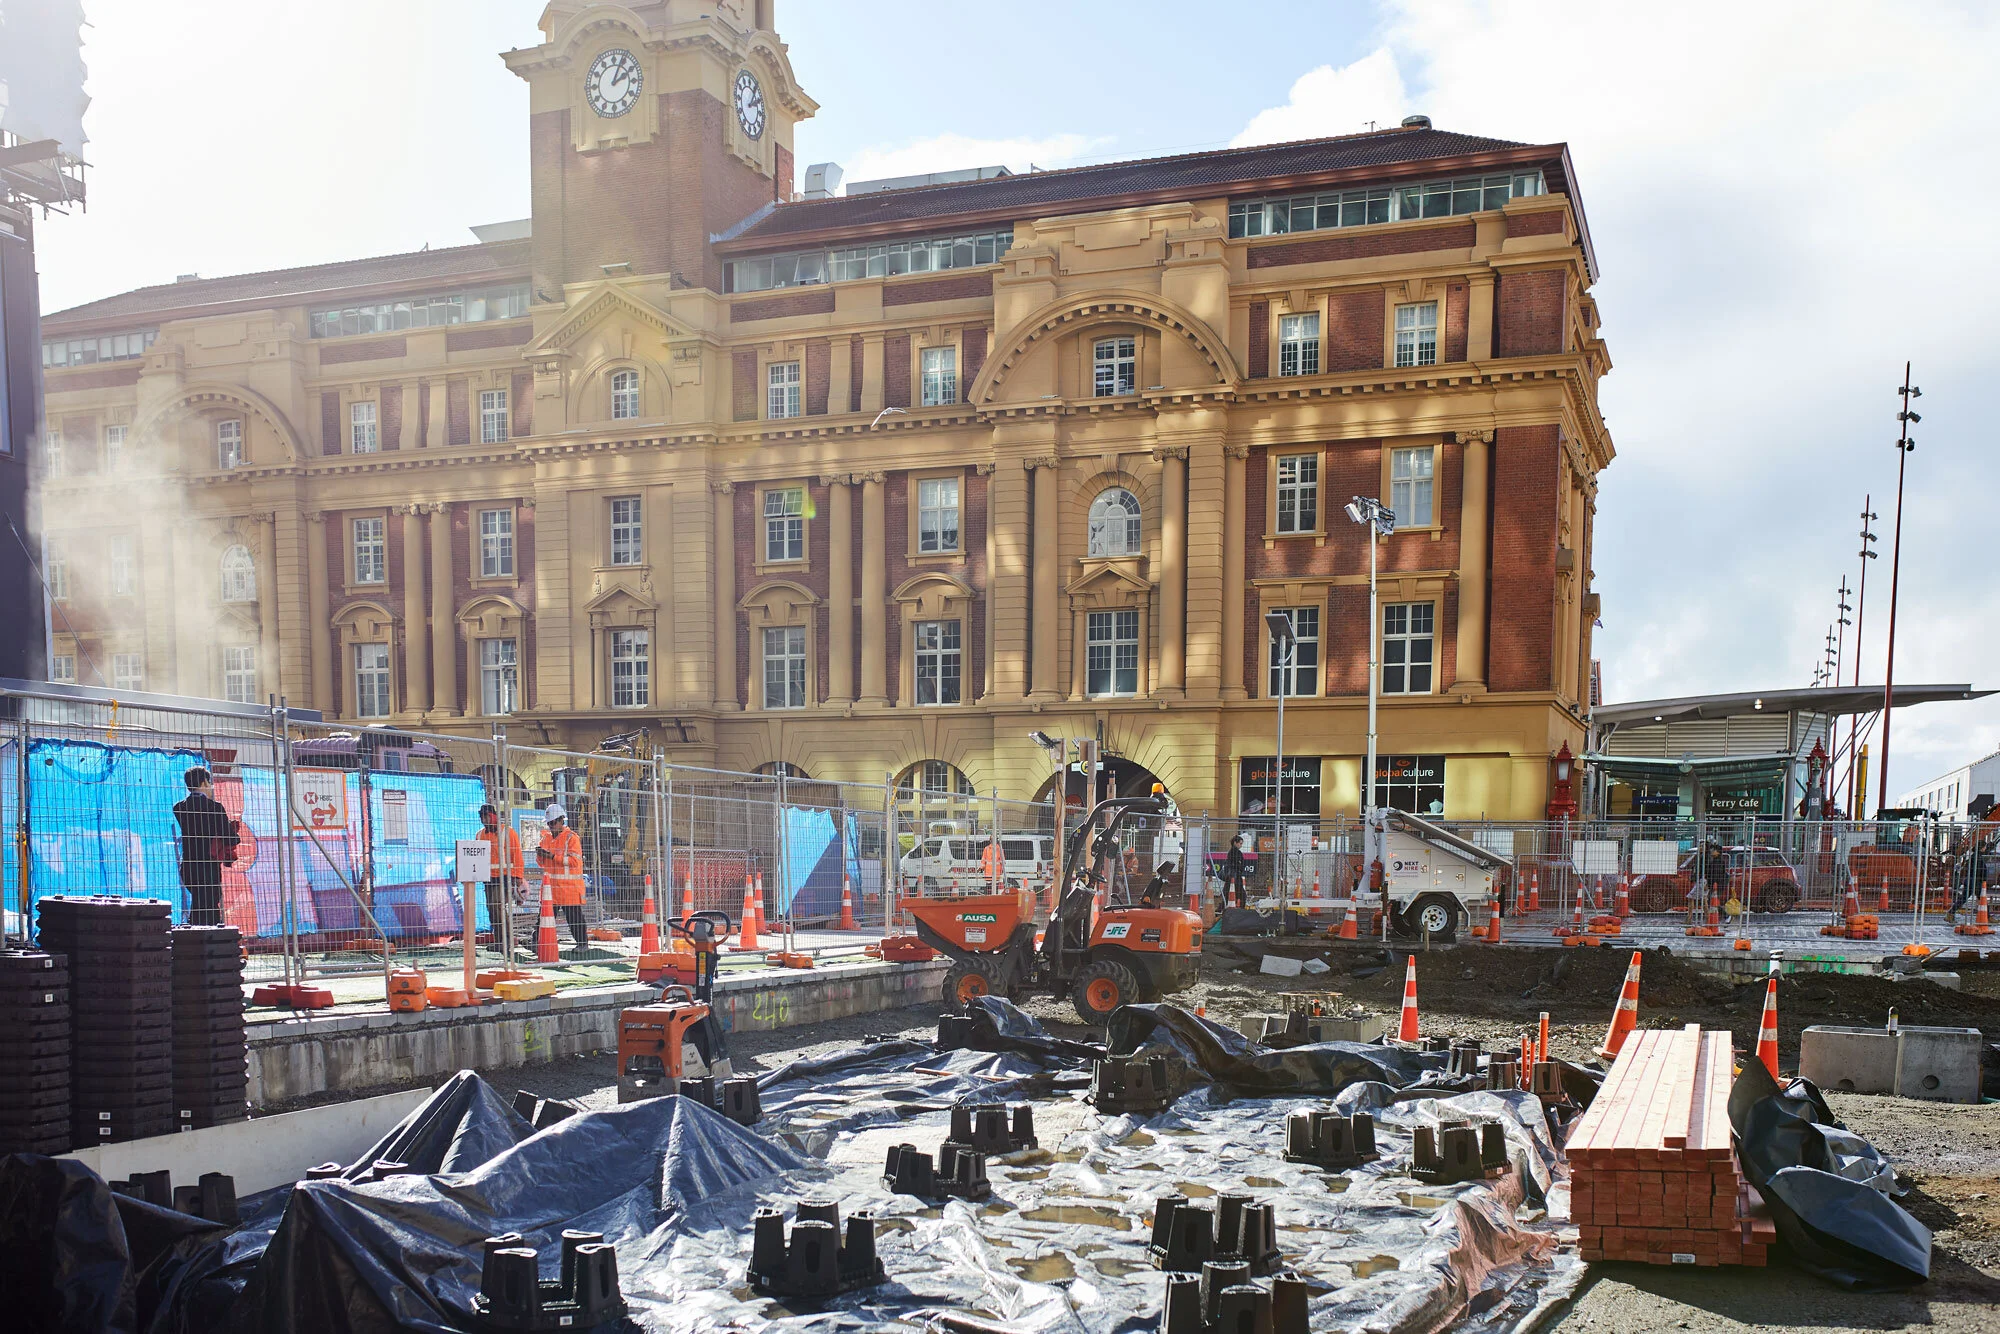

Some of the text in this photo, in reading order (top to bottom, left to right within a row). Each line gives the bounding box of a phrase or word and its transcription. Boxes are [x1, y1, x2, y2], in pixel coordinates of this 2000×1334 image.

[1712, 799, 1759, 809] Ferry Cafe
[462, 847, 486, 856] TREEPIT
[472, 863, 477, 872] 1
[752, 991, 789, 1029] 240
